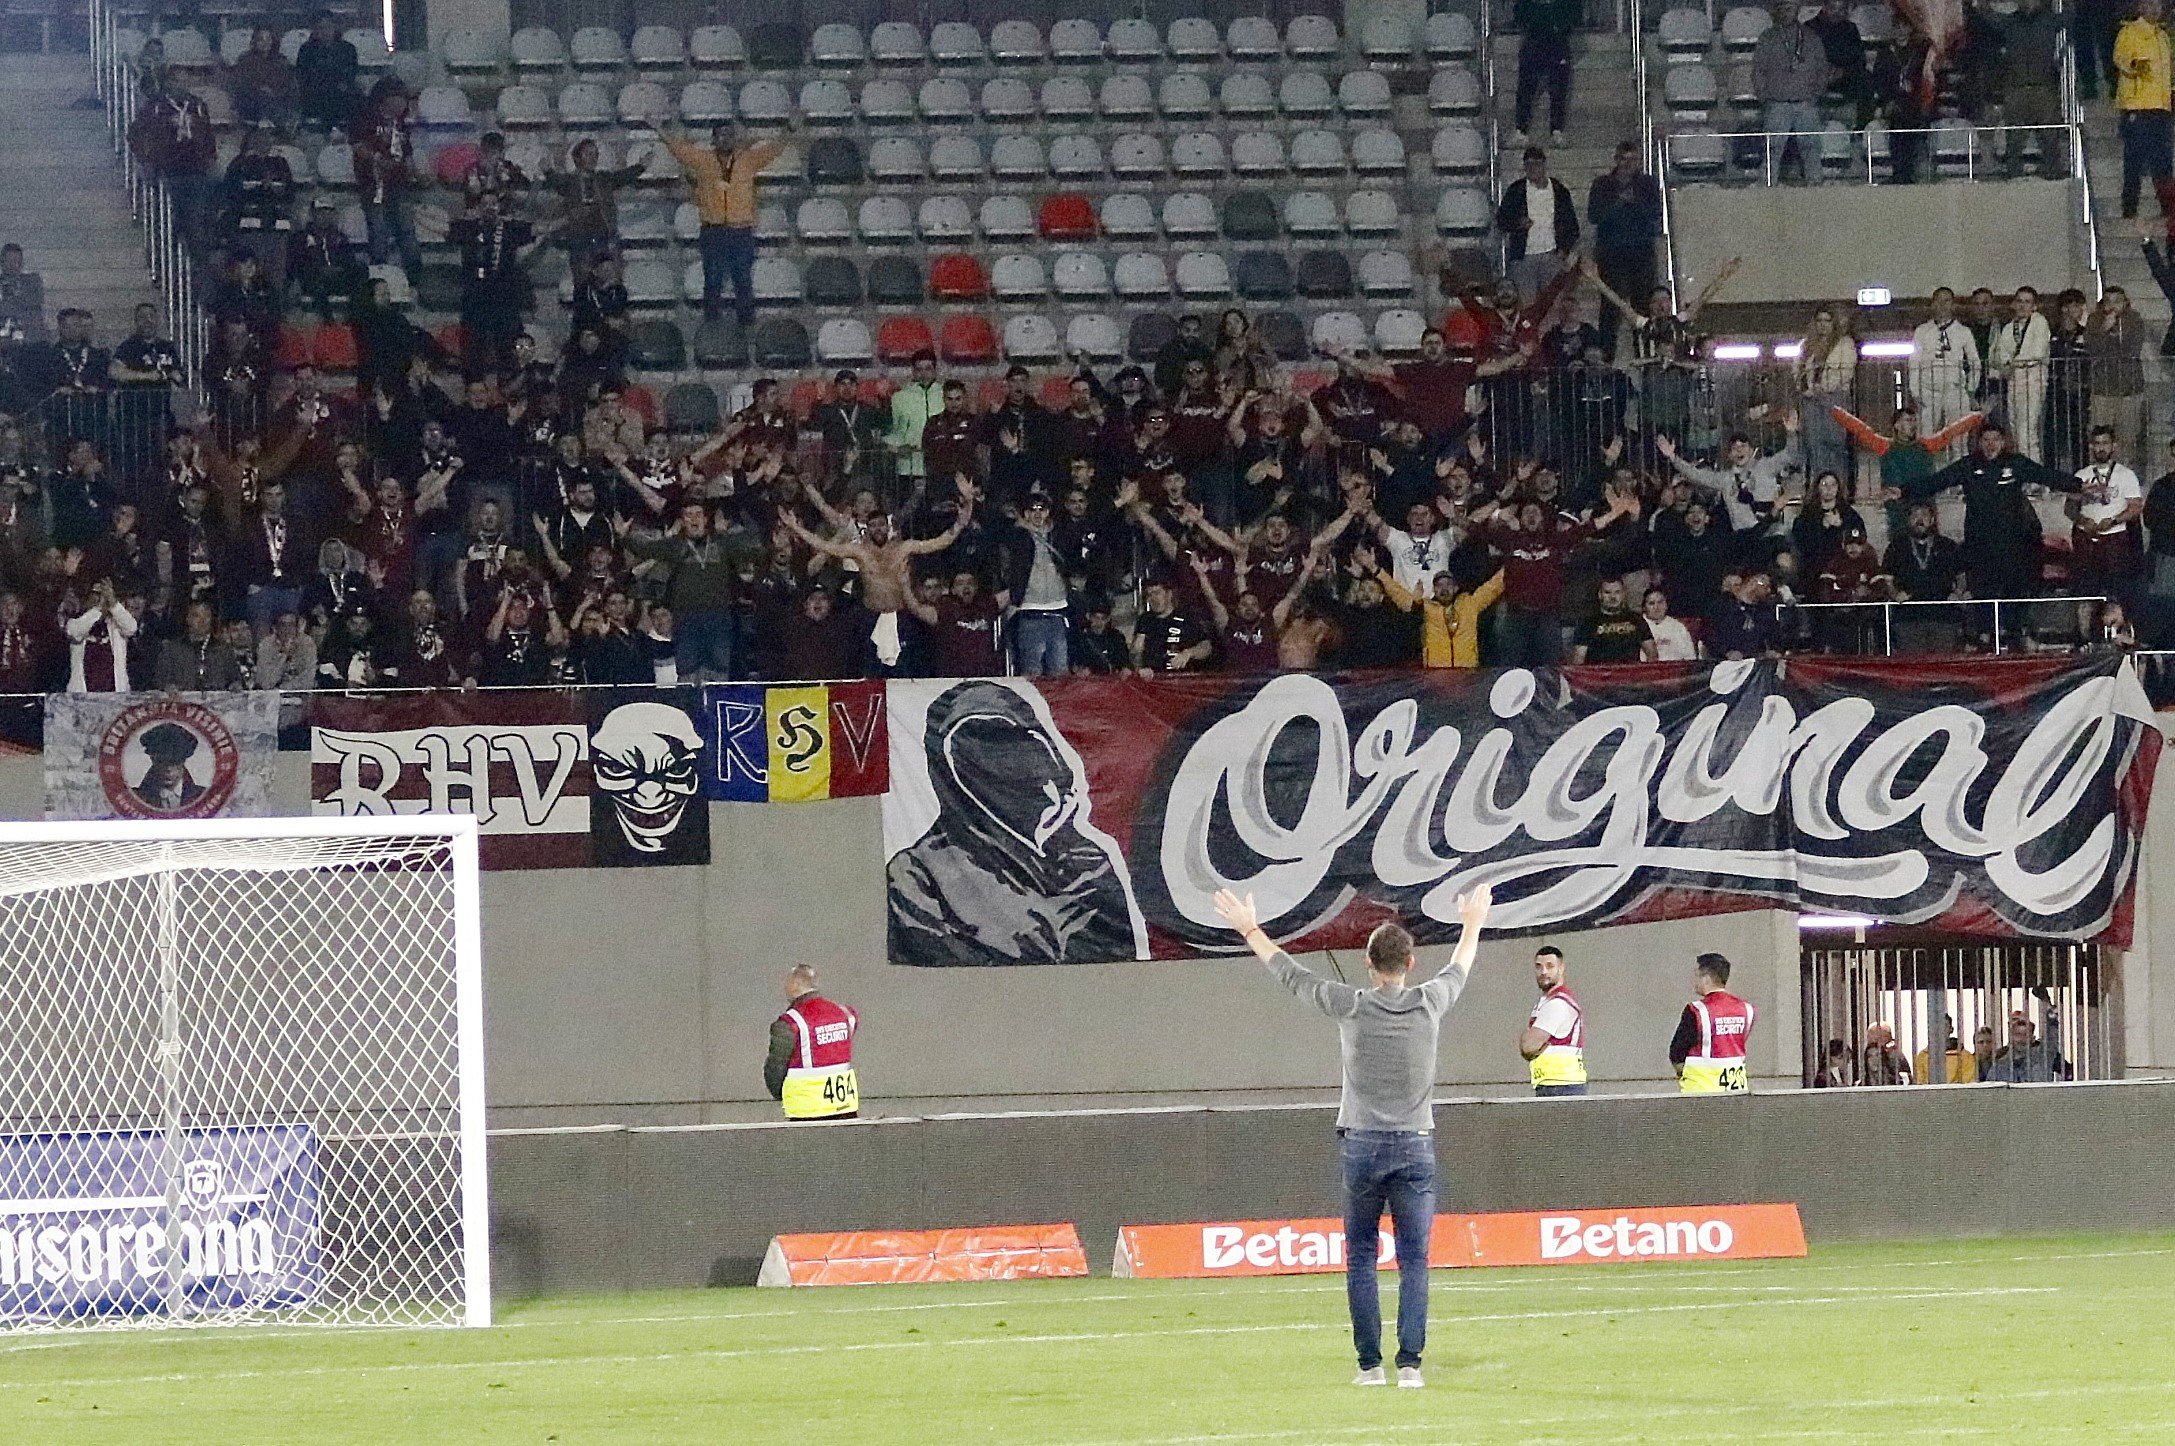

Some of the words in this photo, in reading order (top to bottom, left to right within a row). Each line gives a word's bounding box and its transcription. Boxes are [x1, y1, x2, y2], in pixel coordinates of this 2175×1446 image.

[319, 730, 581, 827] RHV
[1163, 658, 2117, 930] Original
[816, 1029, 848, 1045] SECURITY
[823, 1073, 855, 1104] 464
[1540, 1216, 1734, 1259] Betano
